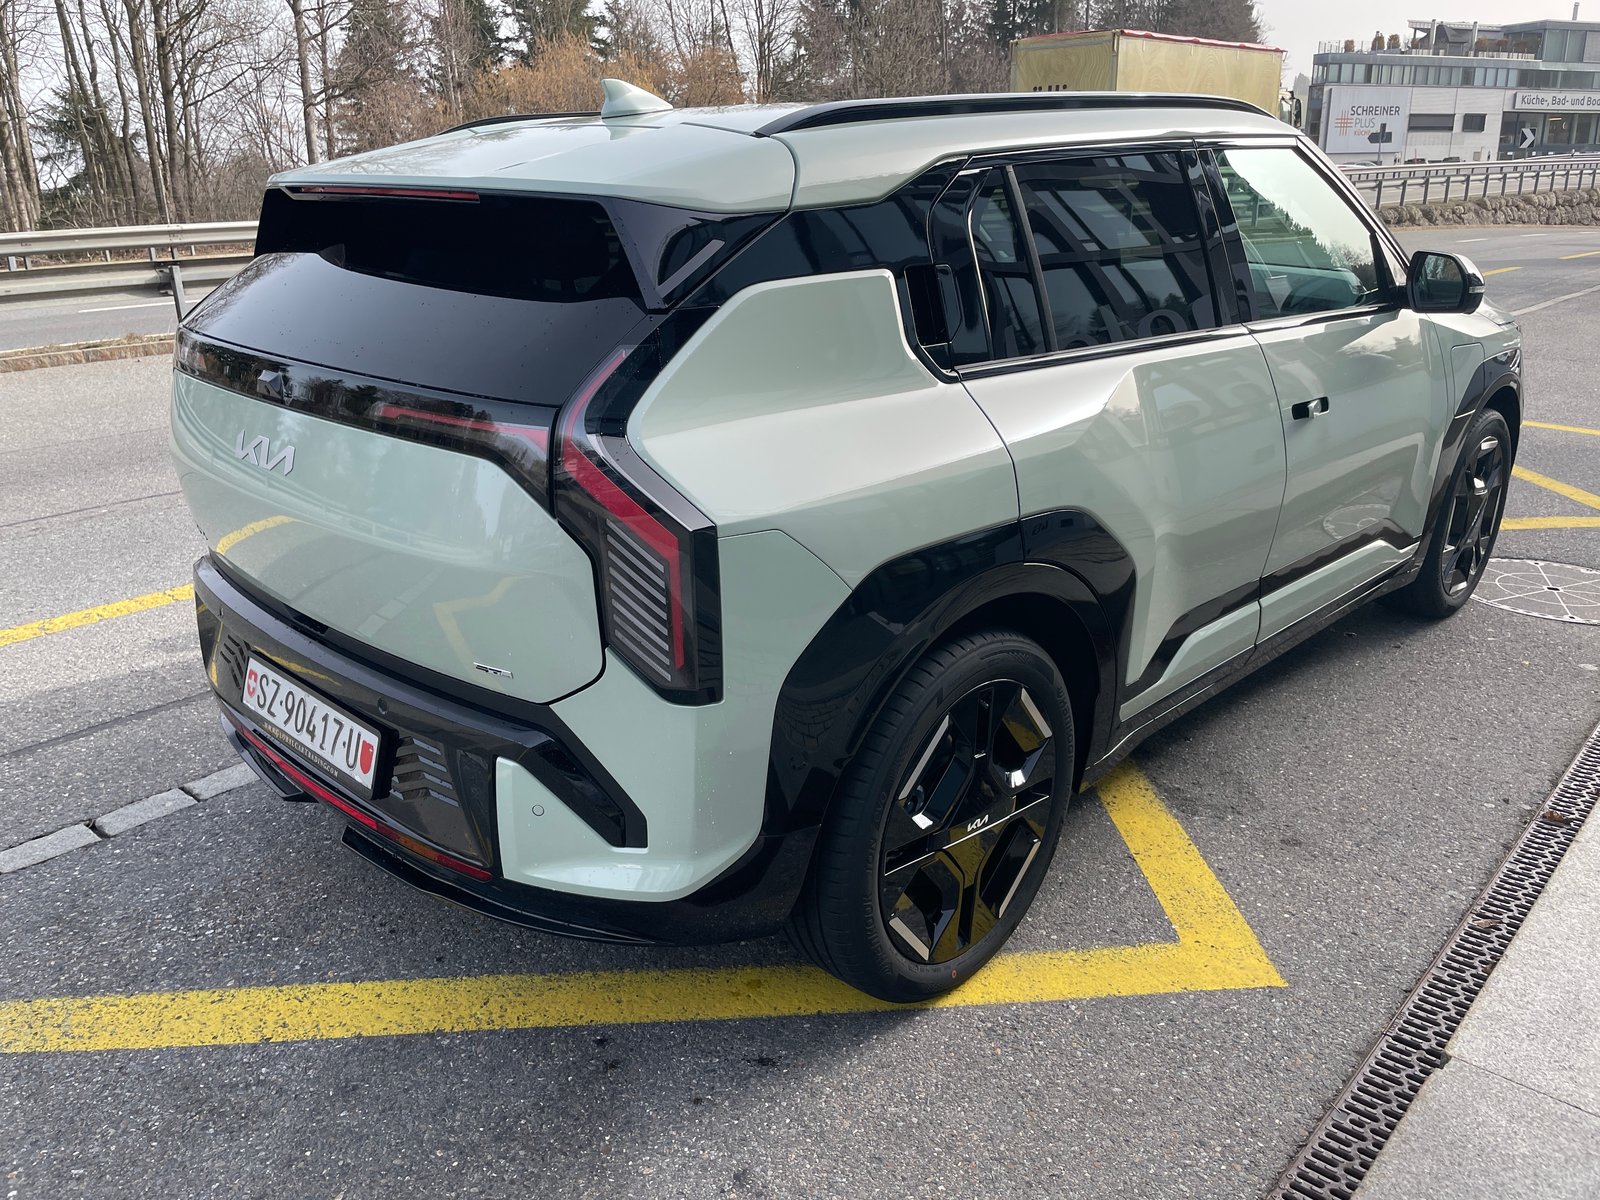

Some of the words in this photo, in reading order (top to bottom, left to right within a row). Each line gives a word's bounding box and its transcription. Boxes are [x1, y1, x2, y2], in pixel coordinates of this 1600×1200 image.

[1551, 95, 1569, 106] Bad-
[1570, 96, 1585, 106] und
[1350, 105, 1400, 116] SCHREINER
[1354, 117, 1376, 128] PLUS
[235, 429, 296, 476] KIA
[967, 814, 989, 832] KIA
